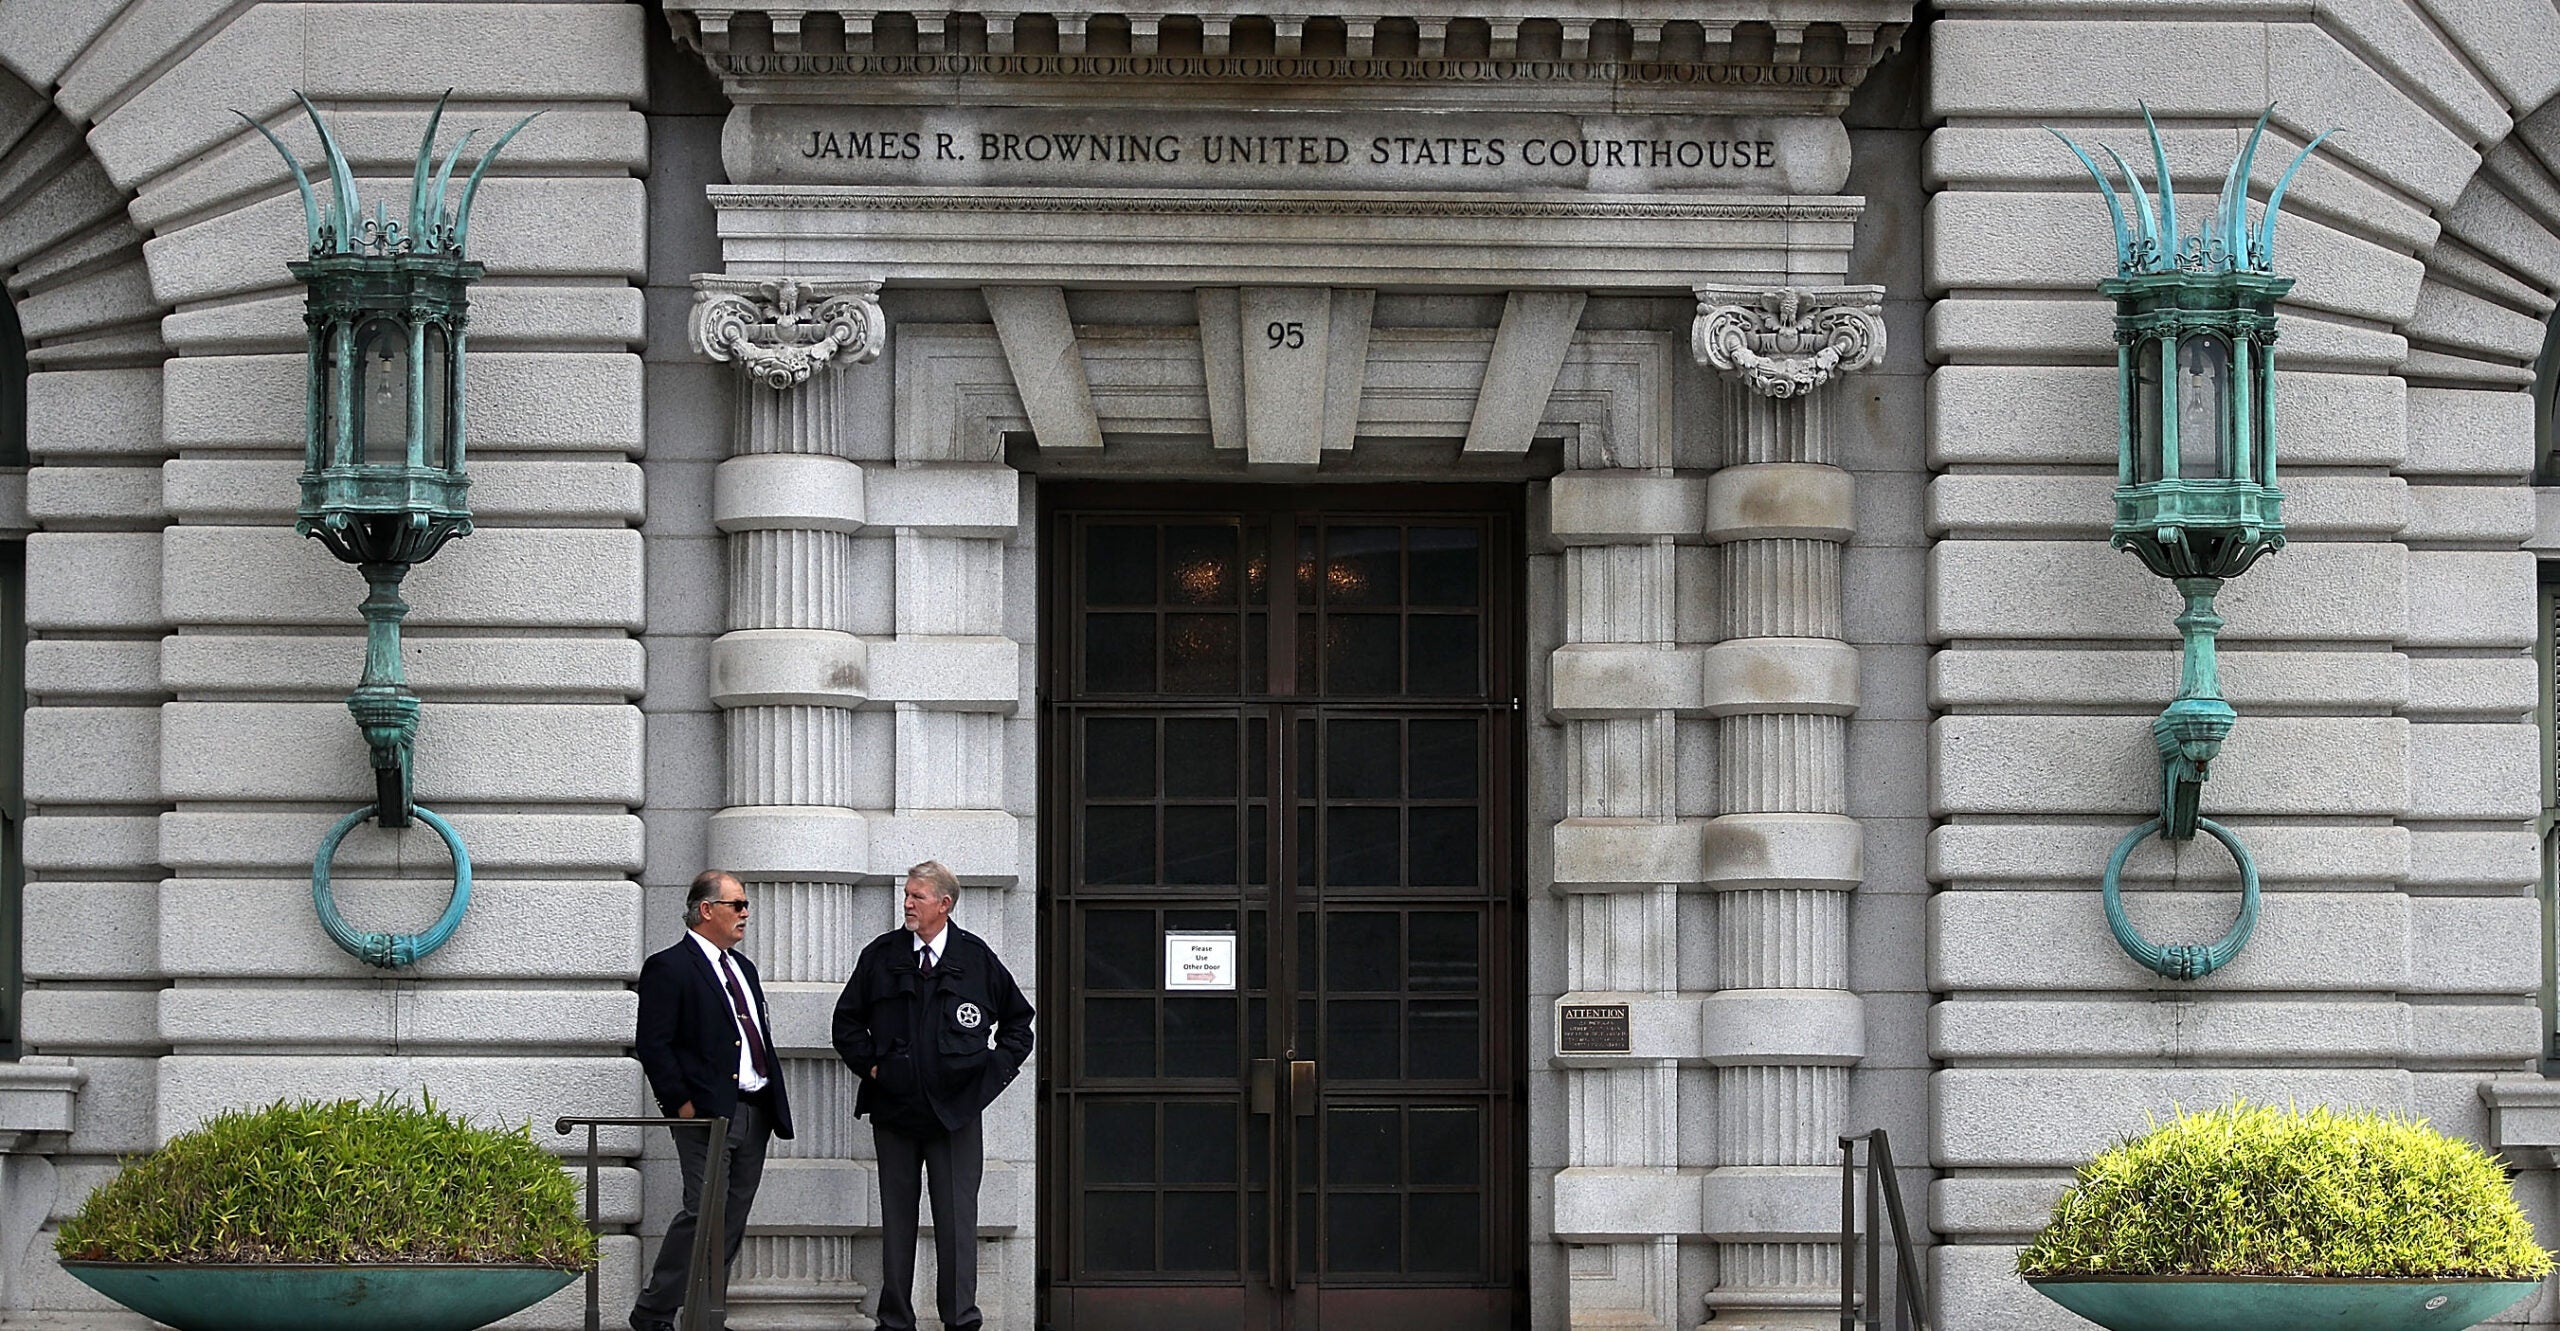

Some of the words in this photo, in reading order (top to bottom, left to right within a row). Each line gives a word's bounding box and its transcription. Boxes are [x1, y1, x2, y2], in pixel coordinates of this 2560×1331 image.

[802, 131, 921, 160] JAMES
[936, 133, 965, 161] R.
[980, 133, 1181, 164] BROWNING
[1202, 135, 1348, 165] UNITED
[1370, 137, 1505, 166] STATES
[1522, 139, 1776, 168] COURTHOUSE
[1267, 322, 1304, 349] 95
[1566, 1009, 1624, 1018] ATTENTION
